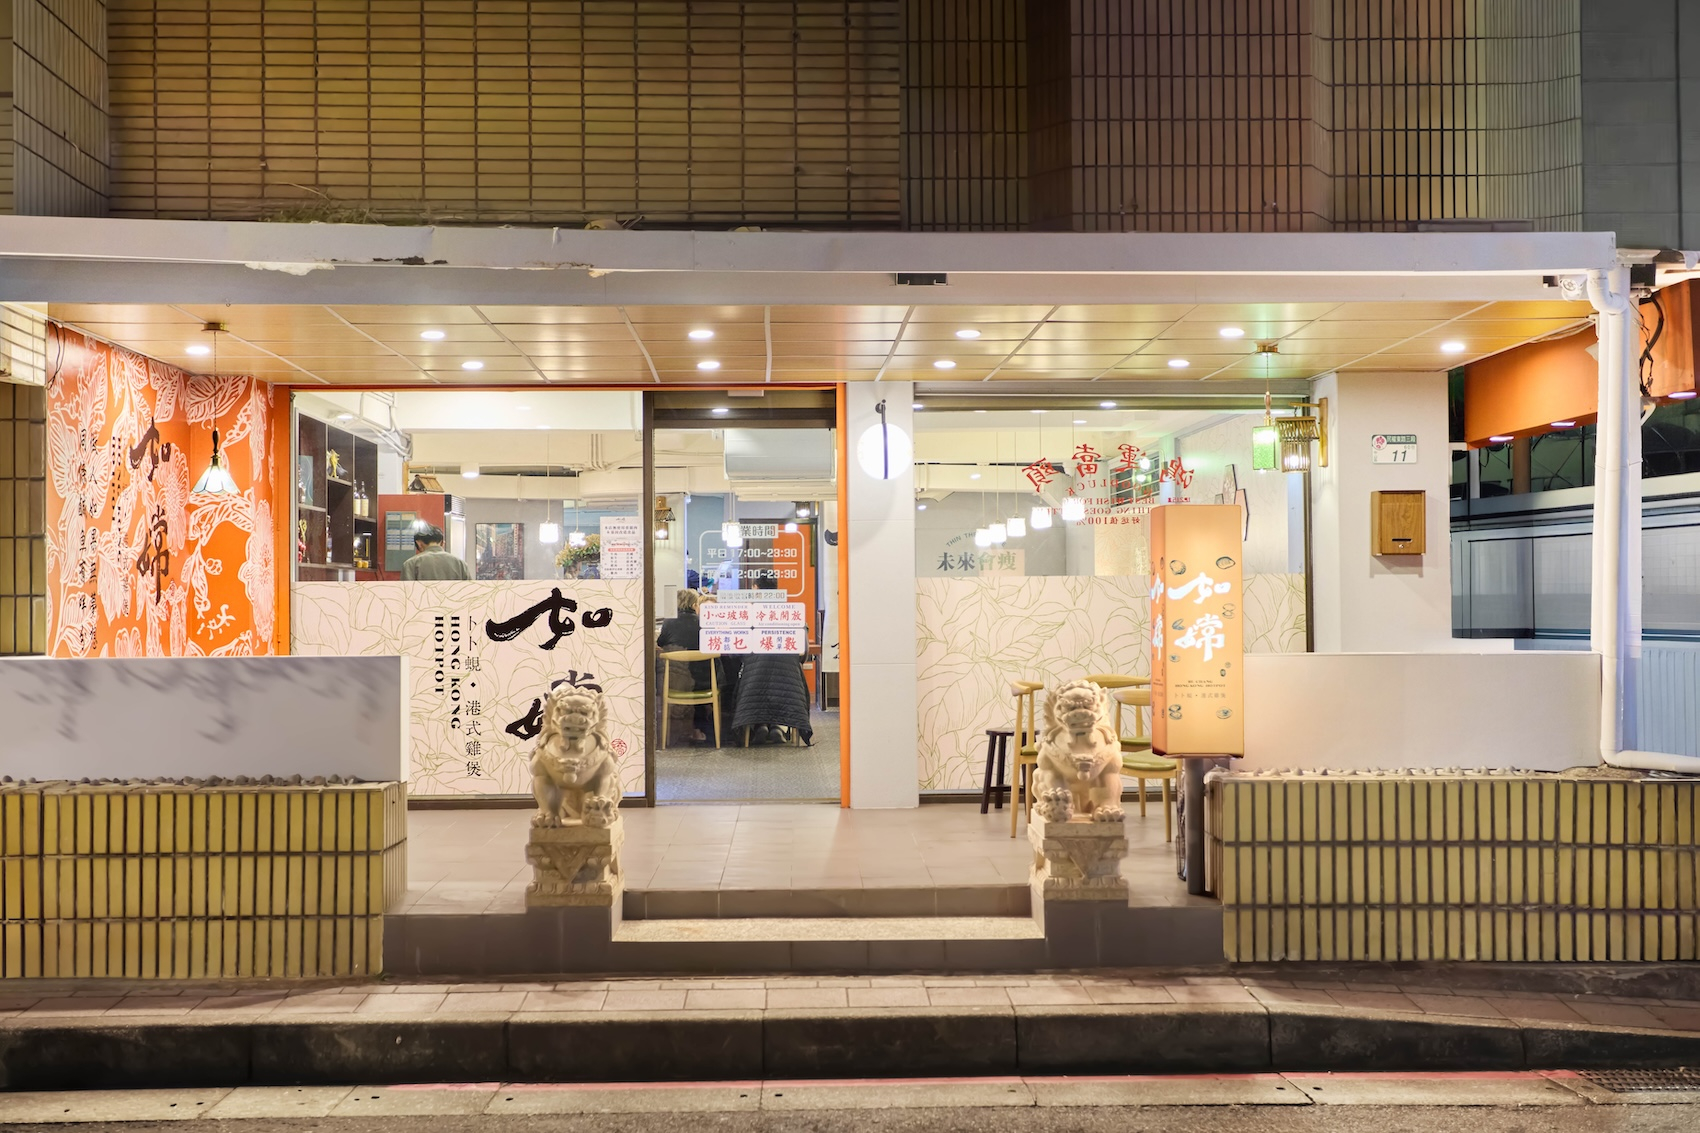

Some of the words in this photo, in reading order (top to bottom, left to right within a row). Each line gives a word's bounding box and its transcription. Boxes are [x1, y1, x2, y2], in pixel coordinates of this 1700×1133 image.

[1392, 450, 1407, 462] 11
[740, 525, 776, 537] 業時間
[731, 548, 798, 558] 17:00~23:30
[936, 552, 1017, 572] 未來會瘦
[737, 569, 798, 579] 2:00~23:30
[764, 592, 786, 600] 22:00
[703, 610, 749, 621] 小心玻璃
[756, 610, 802, 621] 冷氣開放
[451, 616, 461, 670] HONG
[434, 616, 444, 696] HOTPOT
[451, 677, 461, 730] KONG
